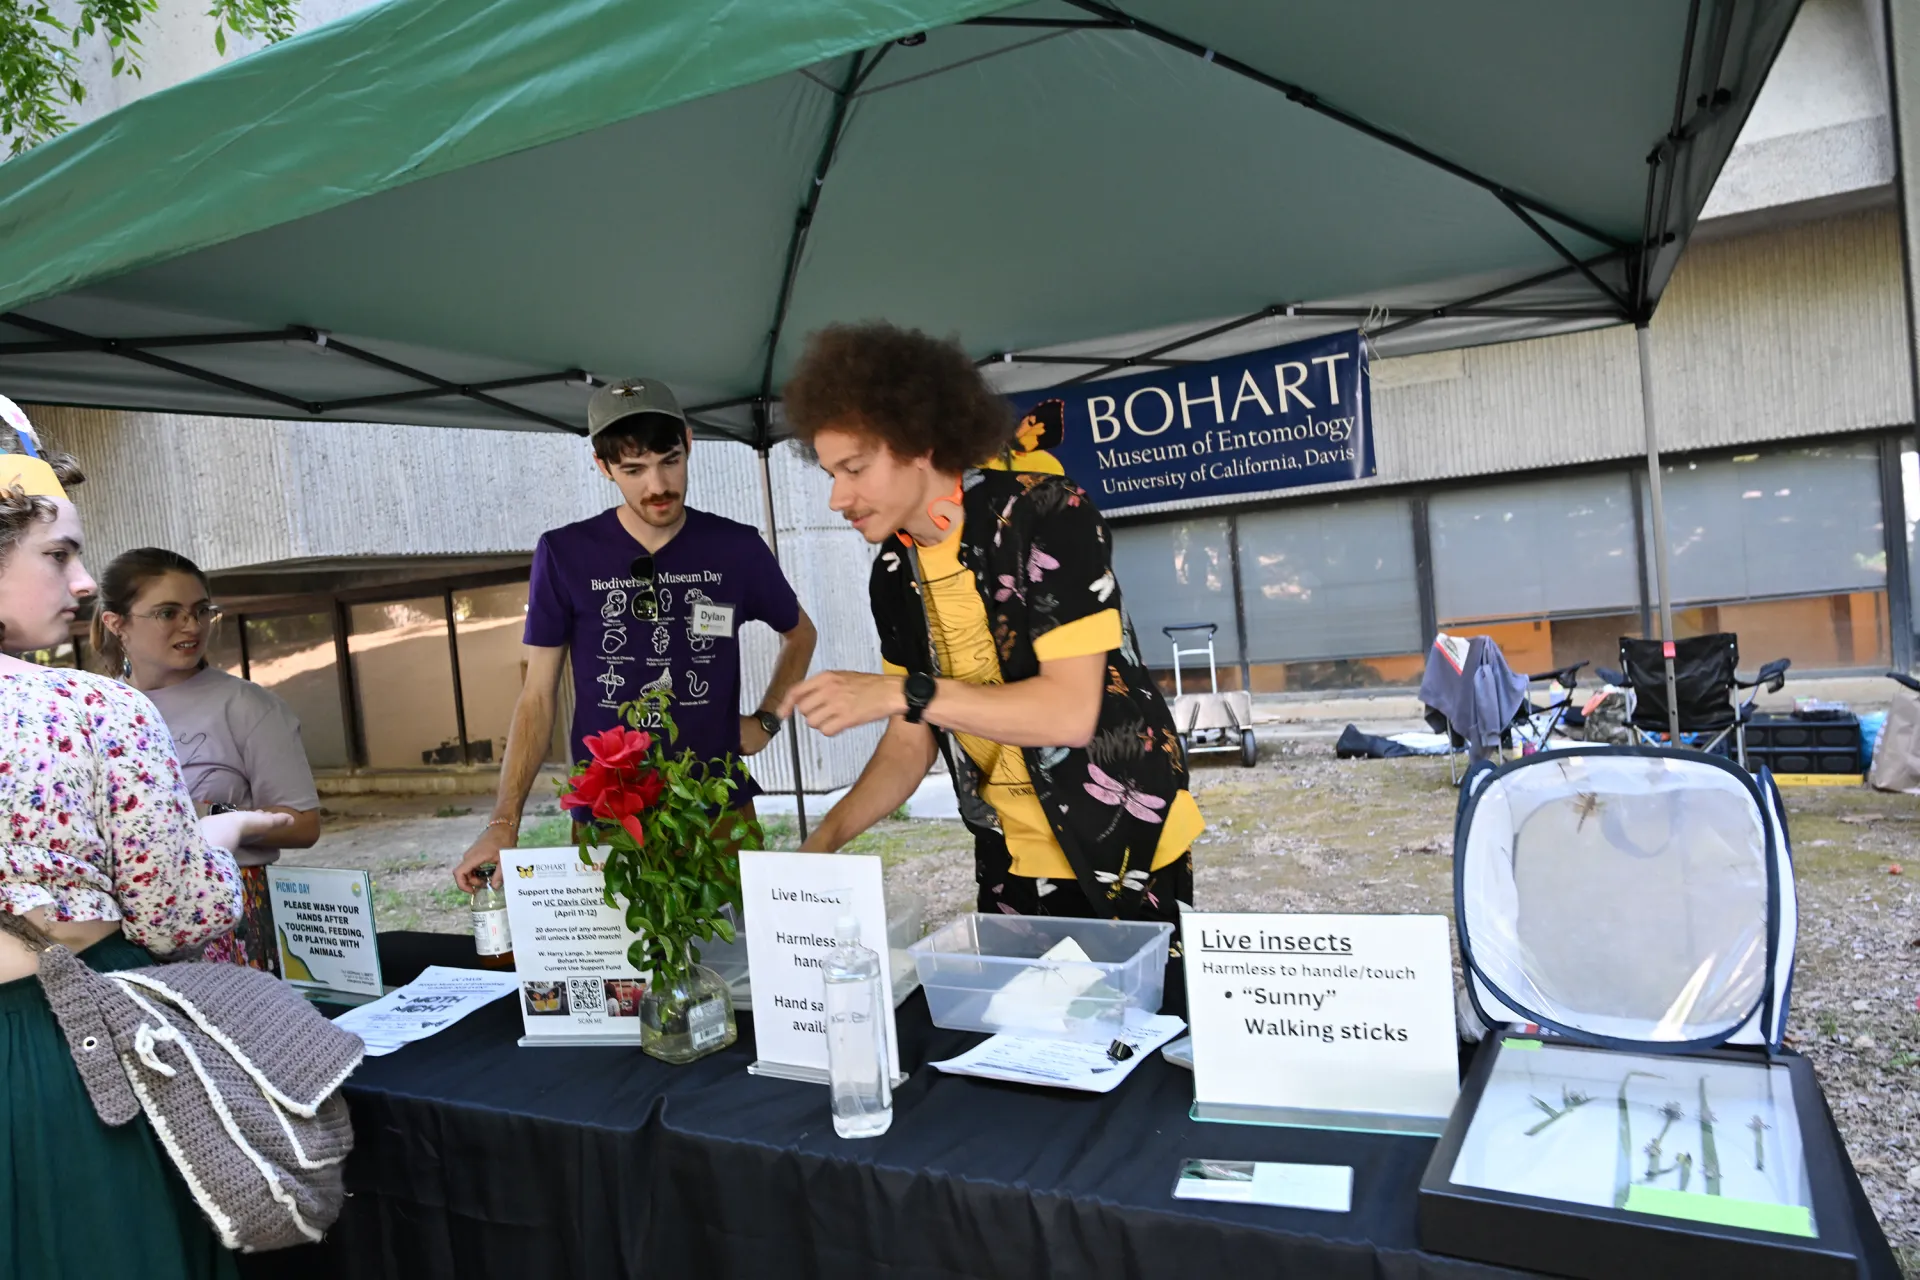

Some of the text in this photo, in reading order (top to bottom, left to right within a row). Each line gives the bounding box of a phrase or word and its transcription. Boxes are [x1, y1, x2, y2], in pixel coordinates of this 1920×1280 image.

[1087, 352, 1349, 443] BOHART
[1096, 414, 1356, 470] Museum of Entomology
[1102, 445, 1356, 495] University of California, Davis
[658, 572, 702, 584] Museum
[703, 570, 723, 585] Day
[701, 611, 726, 622] Dylan
[276, 881, 310, 895] PICNIC DAY
[518, 888, 549, 897] Support
[566, 887, 593, 895] Bohart
[771, 888, 798, 902] Live
[284, 900, 360, 914] PLEASE WASH YOUR
[544, 899, 556, 907] UC
[558, 898, 579, 906] Davis
[580, 898, 598, 906] Give
[296, 912, 349, 925] HANDS AFTER
[554, 908, 598, 918] (April 11-12)
[285, 922, 364, 940] TOUCHING, FEEDING,
[568, 926, 578, 934] (of
[579, 926, 591, 934] any
[592, 925, 622, 933] amount)
[292, 934, 360, 949] OR PLAYING WITH
[776, 931, 837, 948] Harmless
[1200, 928, 1353, 952] Live insects
[310, 947, 346, 958] ANIMALS.
[548, 950, 565, 958] Harry
[566, 950, 585, 958] Lange,
[581, 964, 605, 972] Support
[1202, 961, 1416, 980] Harmless to handle/touch
[774, 994, 808, 1010] Hand
[1244, 1018, 1409, 1043] Walking sticks
